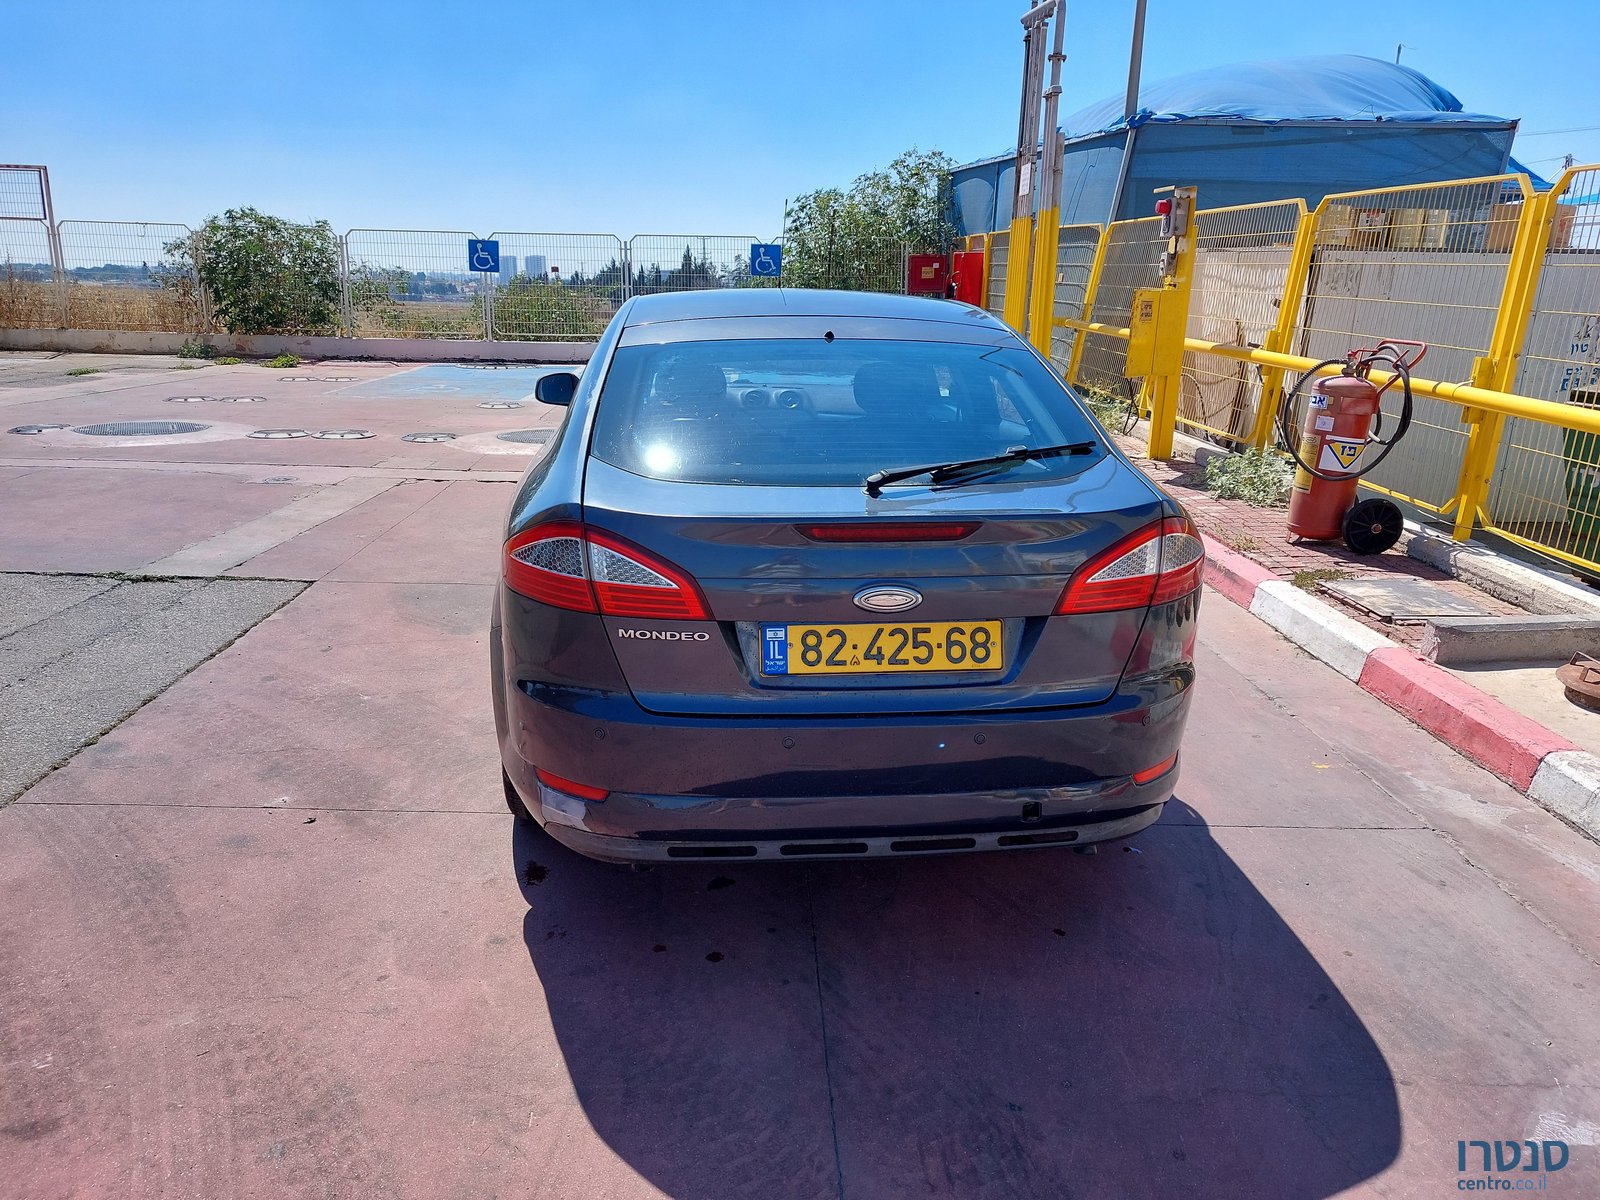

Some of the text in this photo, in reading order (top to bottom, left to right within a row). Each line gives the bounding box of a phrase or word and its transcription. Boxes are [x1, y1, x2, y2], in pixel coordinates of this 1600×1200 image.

[1340, 445, 1357, 457] פז
[618, 628, 710, 641] MONDEO
[769, 640, 783, 659] IL
